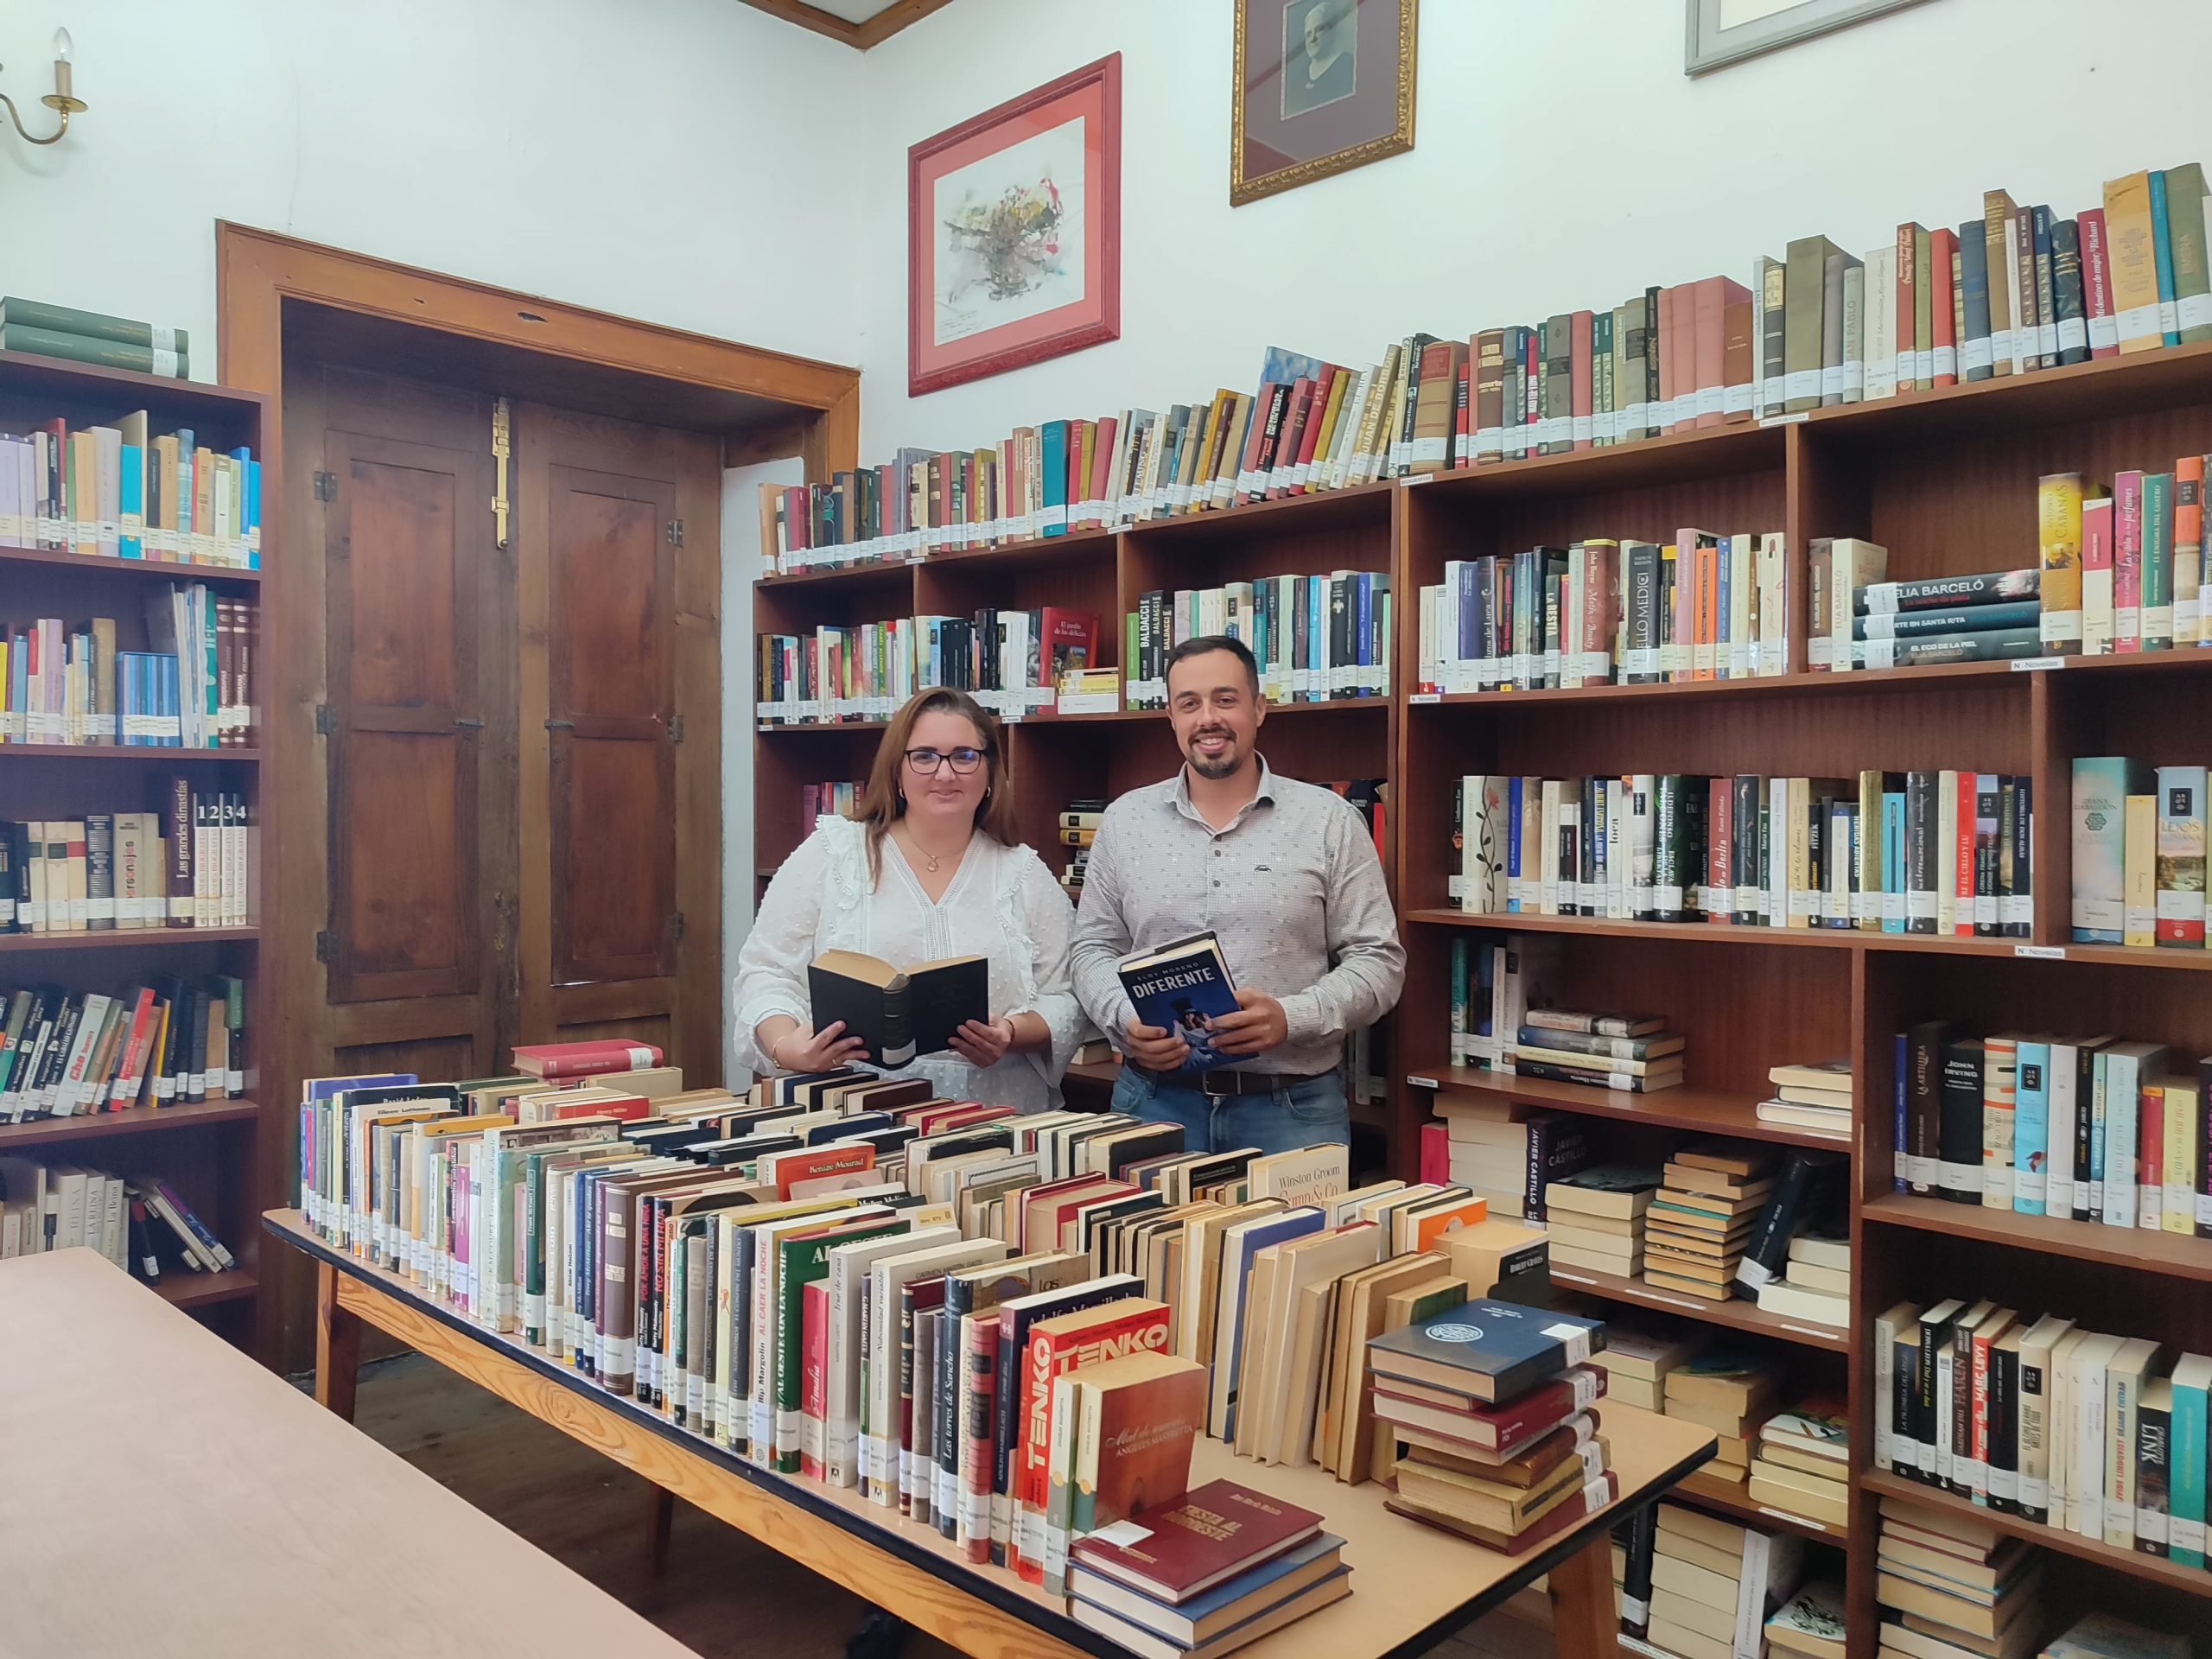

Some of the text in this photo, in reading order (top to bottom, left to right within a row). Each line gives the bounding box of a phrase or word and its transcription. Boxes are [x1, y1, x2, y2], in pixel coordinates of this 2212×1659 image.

[2094, 283, 2104, 308] destino
[1922, 579, 1984, 596] BARCELÓ
[1152, 601, 1160, 635] BALDACCI
[1546, 593, 1557, 636] LA BESTIA
[1637, 572, 1649, 648] ELLO MEDICI
[1922, 618, 1945, 628] SANTA
[1140, 605, 1151, 648] BALDACCI
[1937, 642, 1948, 651] DE
[1949, 641, 1959, 651] LA
[198, 806, 206, 818] 1
[210, 806, 219, 818] 2
[224, 806, 233, 819] 3
[236, 806, 246, 818] 4
[175, 780, 190, 878] Las grandes dinastías
[1609, 818, 1619, 844] loca
[2028, 948, 2063, 957] Novelas
[1132, 968, 1216, 999] DIFERENTE
[1279, 1165, 1340, 1187] Winston Groom
[1530, 1128, 1540, 1206] JAVIER CASTILLO
[657, 1208, 665, 1234] HIJA
[657, 1236, 664, 1250] MI
[654, 1276, 664, 1293] NO
[760, 1278, 766, 1290] LA
[836, 1283, 842, 1293] de
[760, 1320, 766, 1336] AL
[1054, 1323, 1169, 1377] TENKO
[758, 1342, 766, 1385] Margolin
[1974, 1344, 1986, 1403] MARC LEVY
[809, 1365, 821, 1415] Amalia
[943, 1351, 955, 1459] Las torres de Sancho
[1027, 1337, 1051, 1471] TENKO
[2141, 1422, 2157, 1463] LINK
